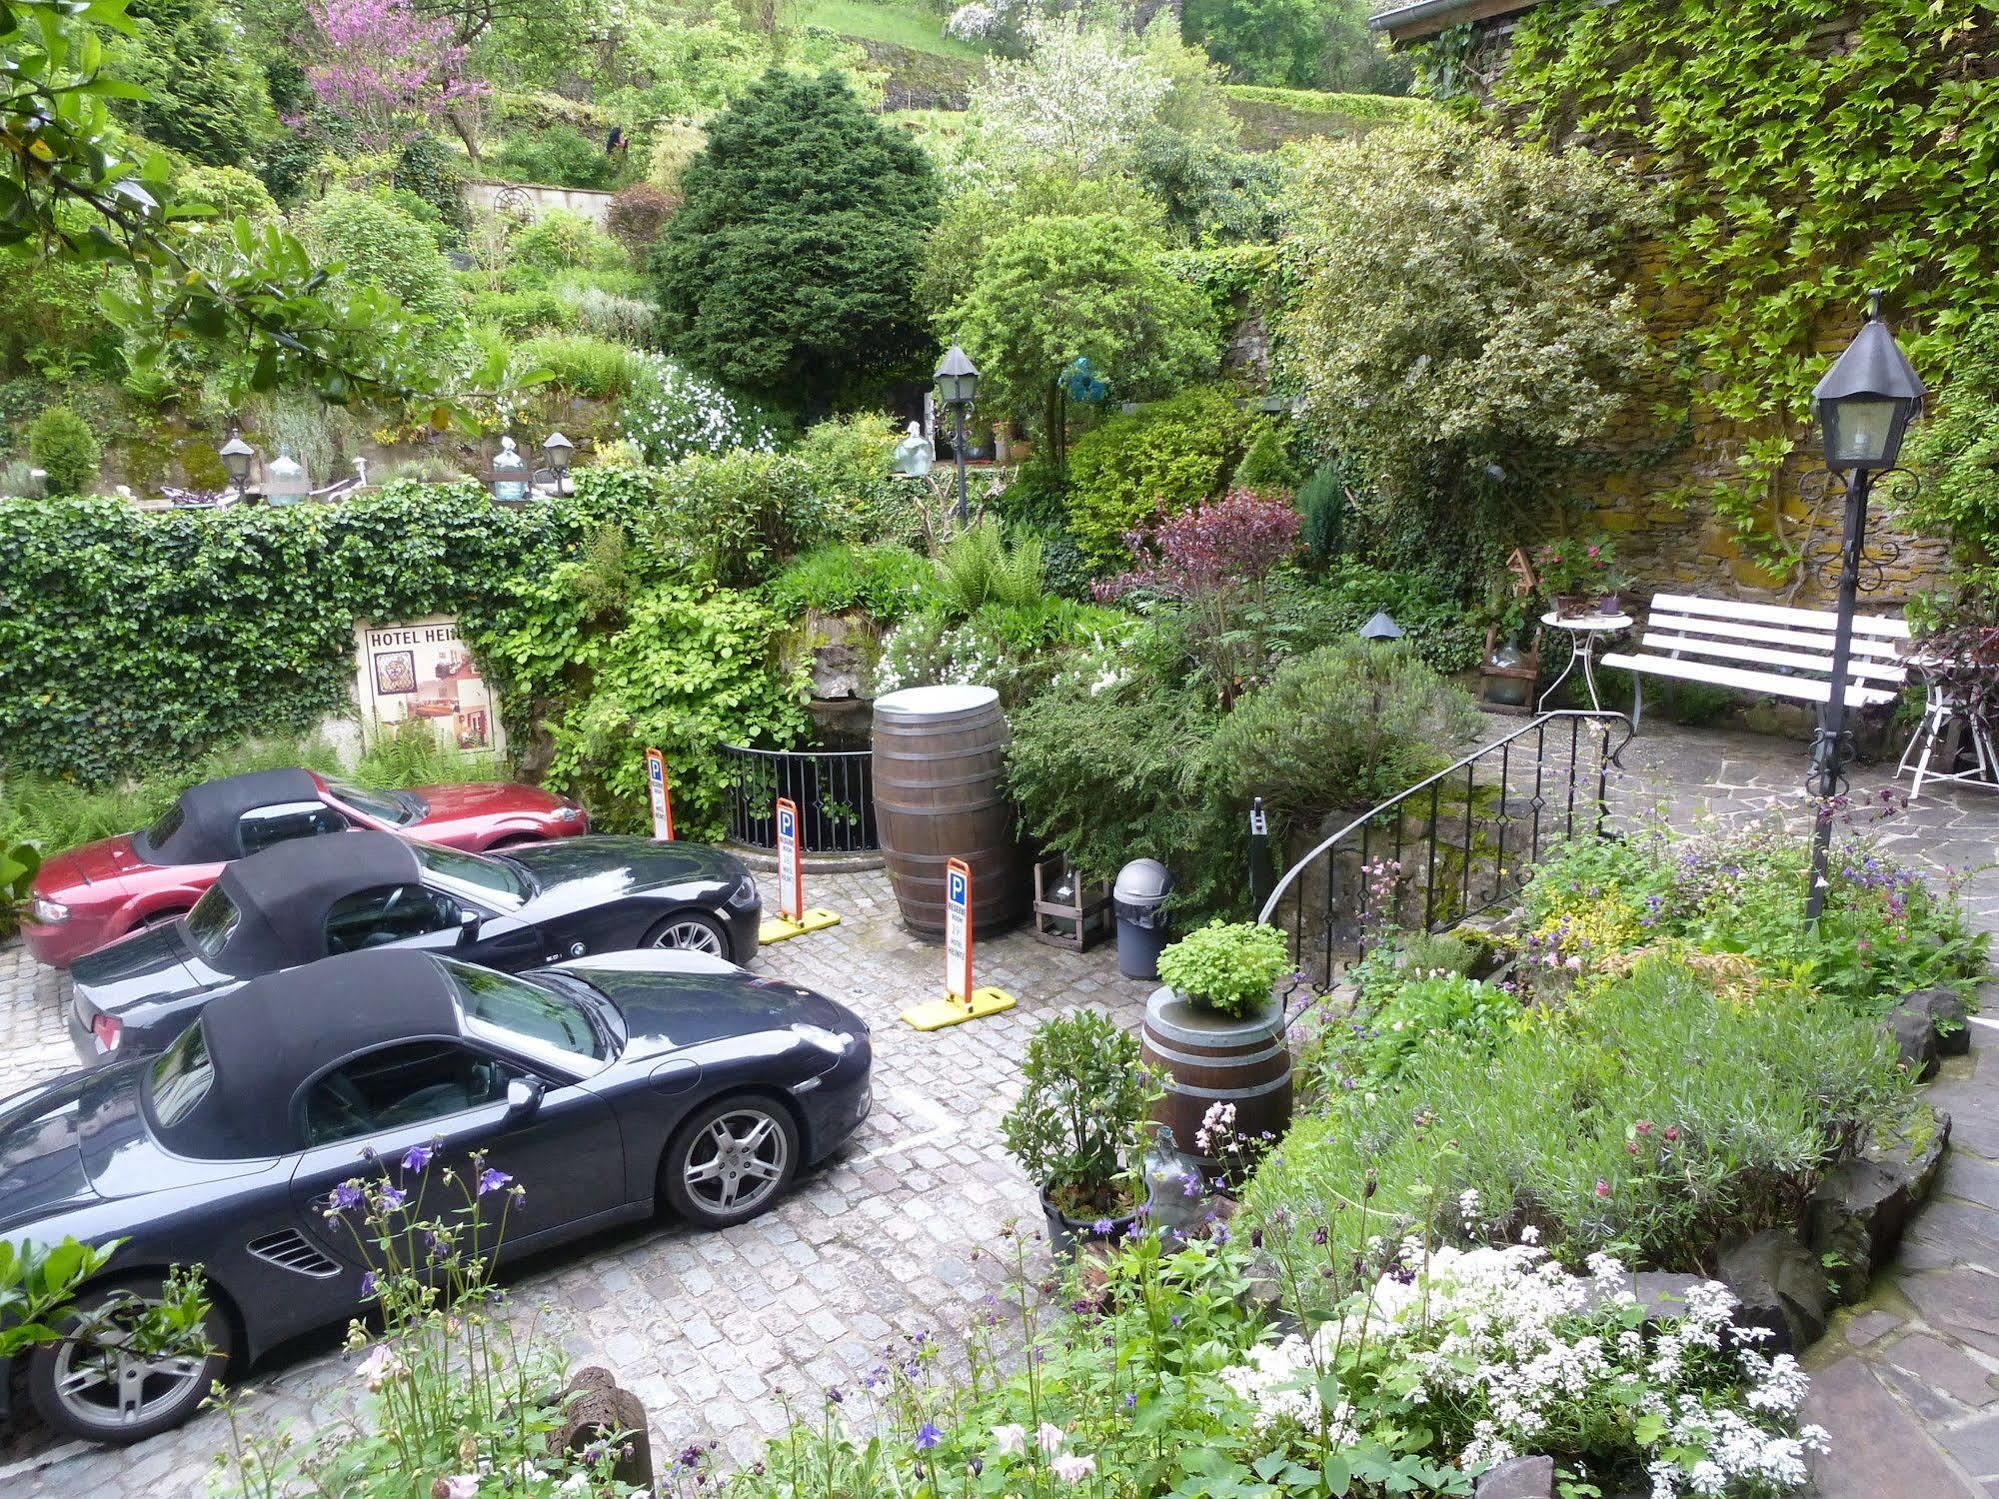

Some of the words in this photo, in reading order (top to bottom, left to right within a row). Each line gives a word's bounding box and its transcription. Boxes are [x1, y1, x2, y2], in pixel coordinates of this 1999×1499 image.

[371, 631, 420, 647] HOTEL
[652, 762, 659, 778] P
[782, 813, 791, 833] P
[952, 876, 962, 899] P
